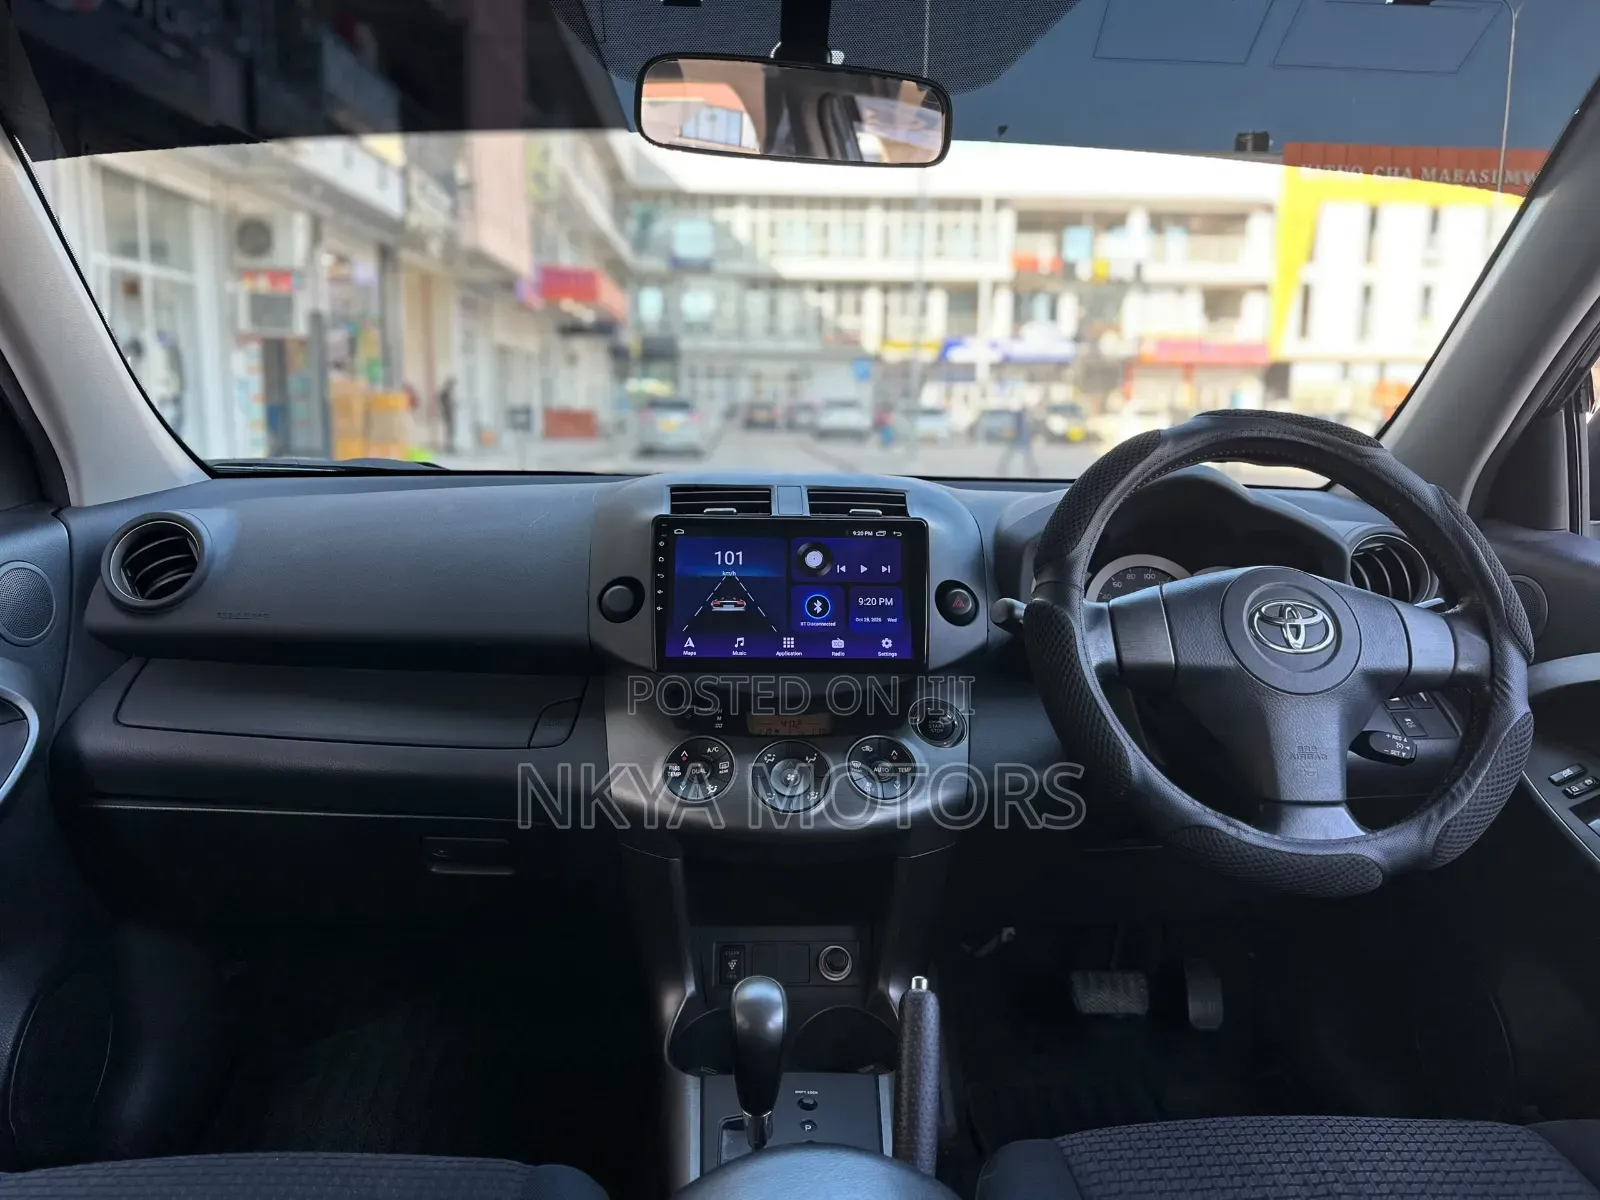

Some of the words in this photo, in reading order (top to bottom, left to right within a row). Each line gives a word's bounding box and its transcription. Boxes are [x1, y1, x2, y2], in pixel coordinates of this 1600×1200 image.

[1420, 167, 1499, 185] MABASI
[714, 550, 743, 566] 101
[858, 597, 877, 606] 9:20
[878, 597, 894, 606] PM
[706, 746, 719, 754] A/C
[804, 1124, 812, 1132] P
